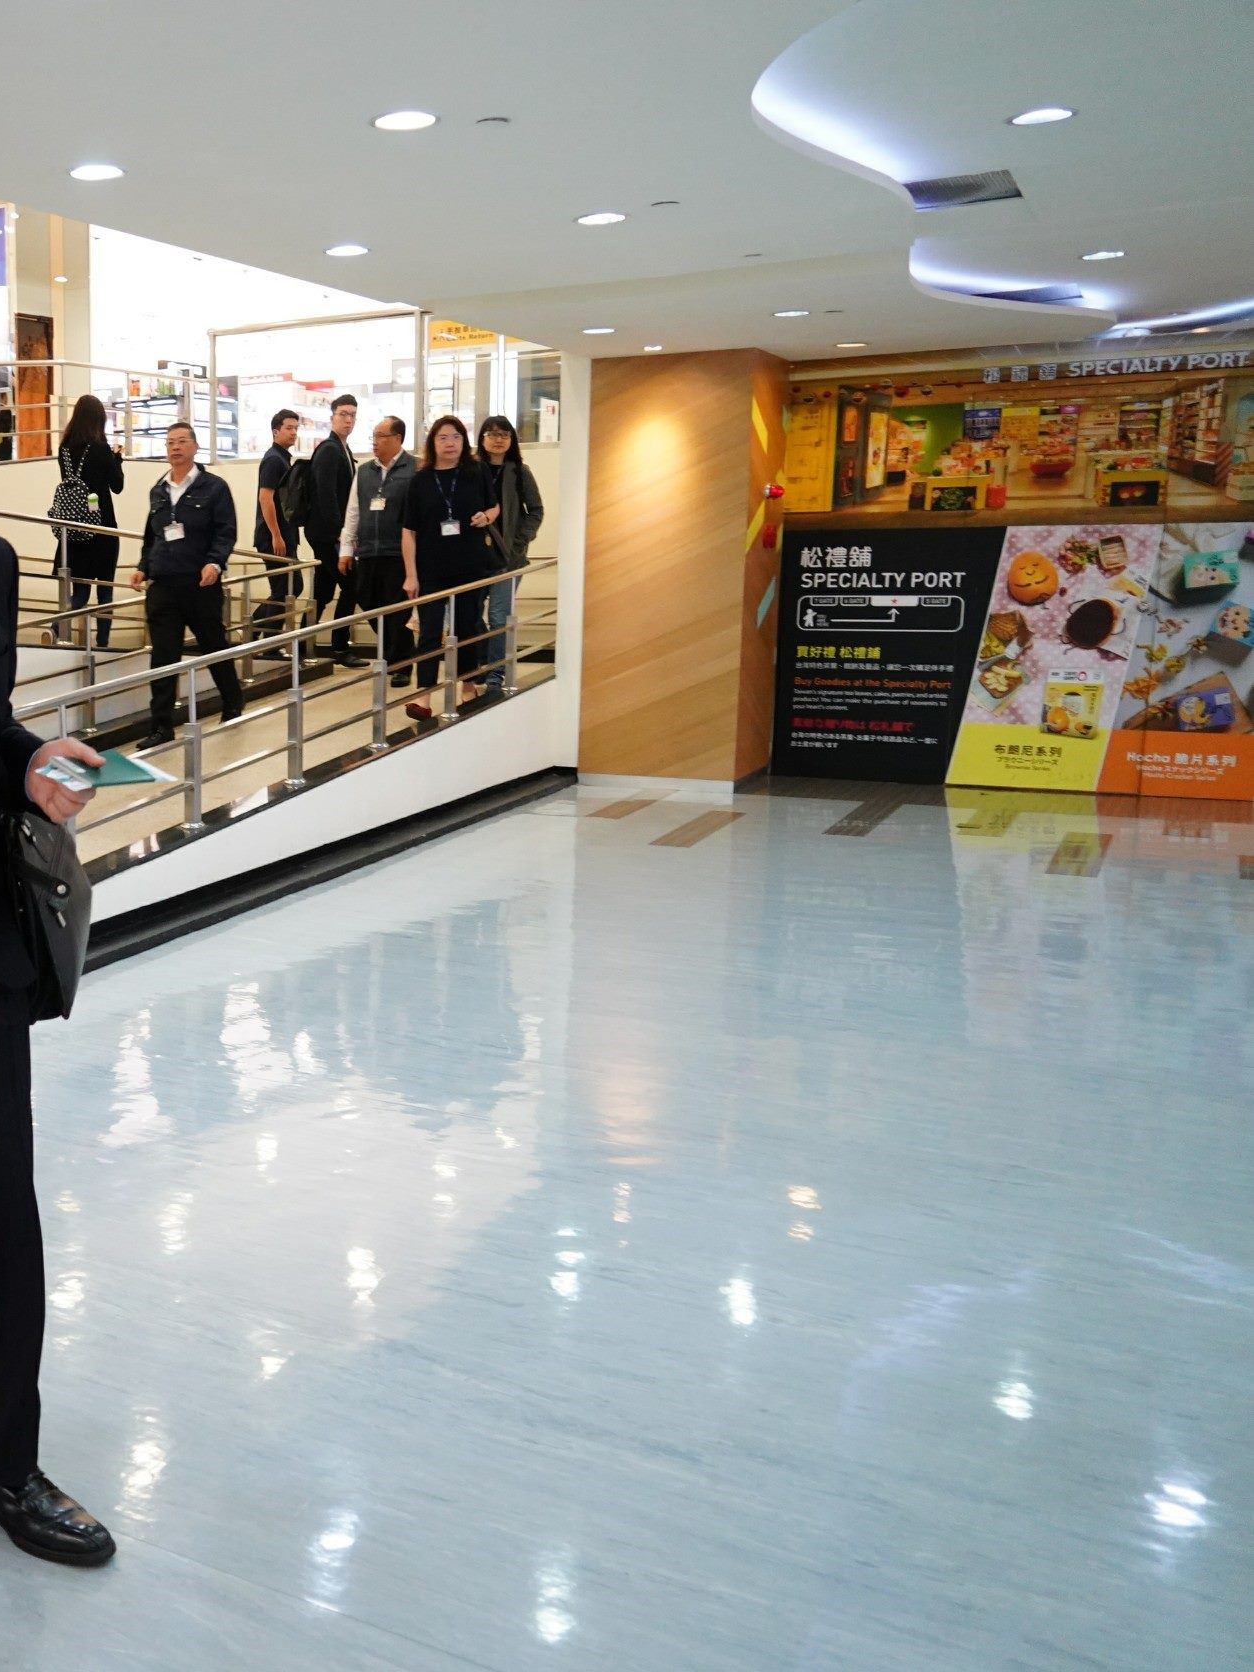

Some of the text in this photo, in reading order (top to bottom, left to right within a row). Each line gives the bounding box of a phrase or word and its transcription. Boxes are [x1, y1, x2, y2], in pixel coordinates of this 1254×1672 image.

[1068, 355, 1182, 377] SPECIALTY
[1187, 351, 1249, 370] PORT
[801, 572, 966, 588] SPECIALTY PORT
[794, 677, 812, 687] Buy
[883, 679, 928, 690] Specialty
[929, 680, 951, 689] Port
